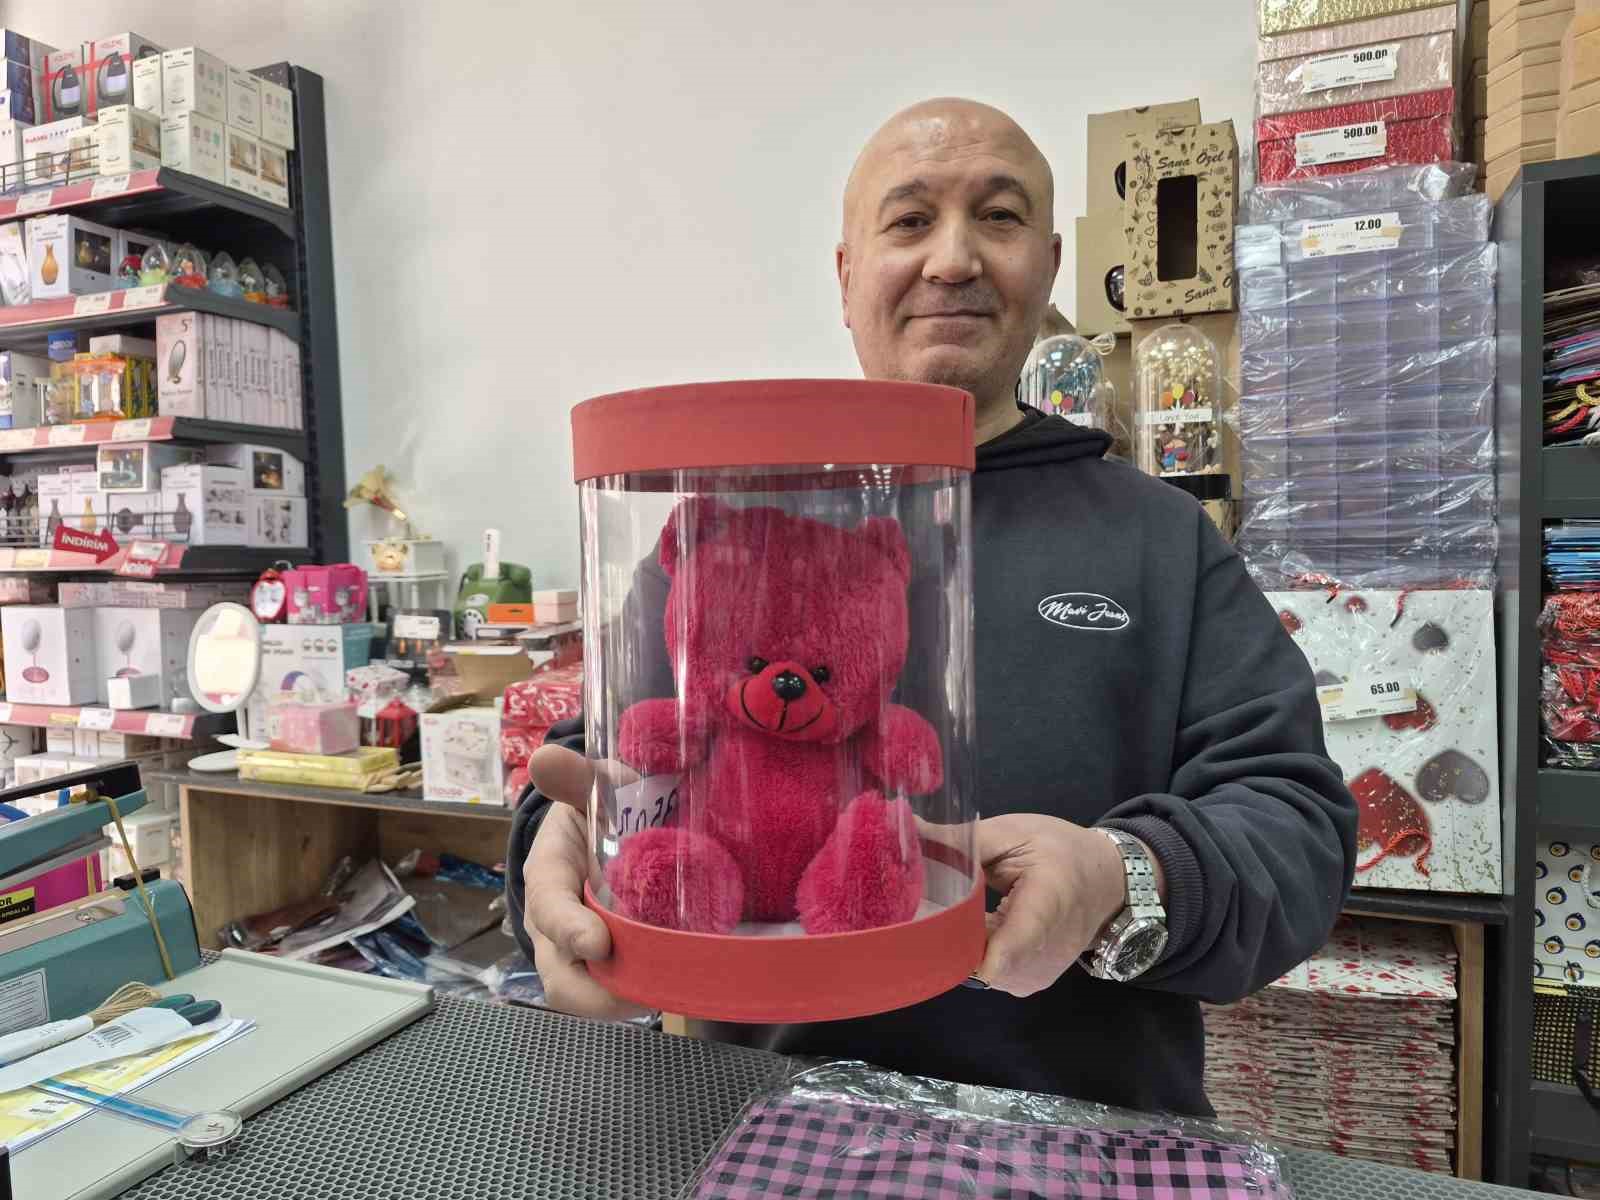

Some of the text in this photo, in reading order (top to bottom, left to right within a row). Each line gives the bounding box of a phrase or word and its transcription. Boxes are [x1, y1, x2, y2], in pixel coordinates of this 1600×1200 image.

[1353, 49, 1388, 63] 500.00
[1343, 125, 1378, 139] 500.00
[1156, 156, 1191, 170] Sana
[1354, 218, 1382, 231] 12.00
[1185, 286, 1217, 304] Sana
[1041, 601, 1088, 620] Mavi
[1370, 681, 1400, 695] 65.00
